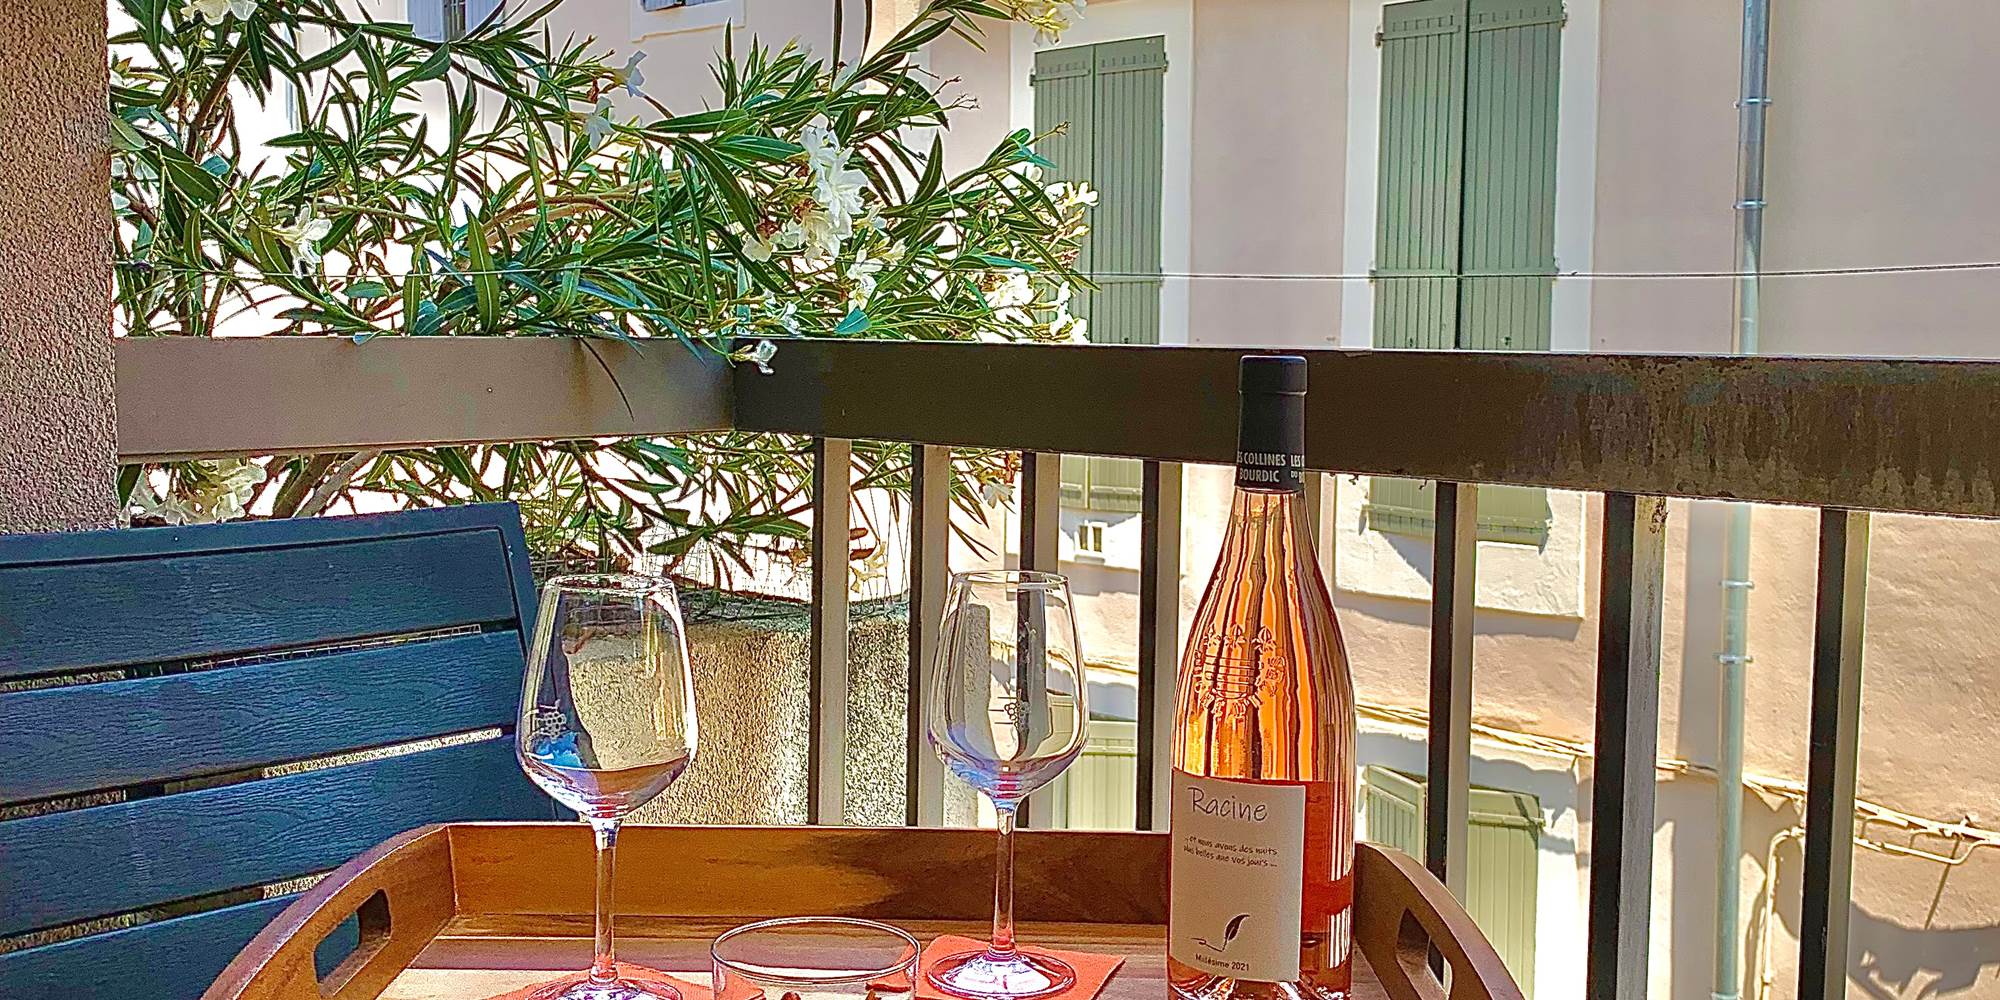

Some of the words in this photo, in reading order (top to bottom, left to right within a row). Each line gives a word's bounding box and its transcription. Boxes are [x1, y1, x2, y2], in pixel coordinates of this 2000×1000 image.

[1243, 452, 1286, 467] COLLINES
[1290, 454, 1301, 468] LES
[1239, 467, 1281, 483] BOURDIC
[1187, 786, 1268, 822] Racine
[1214, 842, 1237, 852] avons
[1239, 844, 1254, 854] des
[1246, 859, 1269, 868] jours
[1231, 961, 1250, 971] 2021
